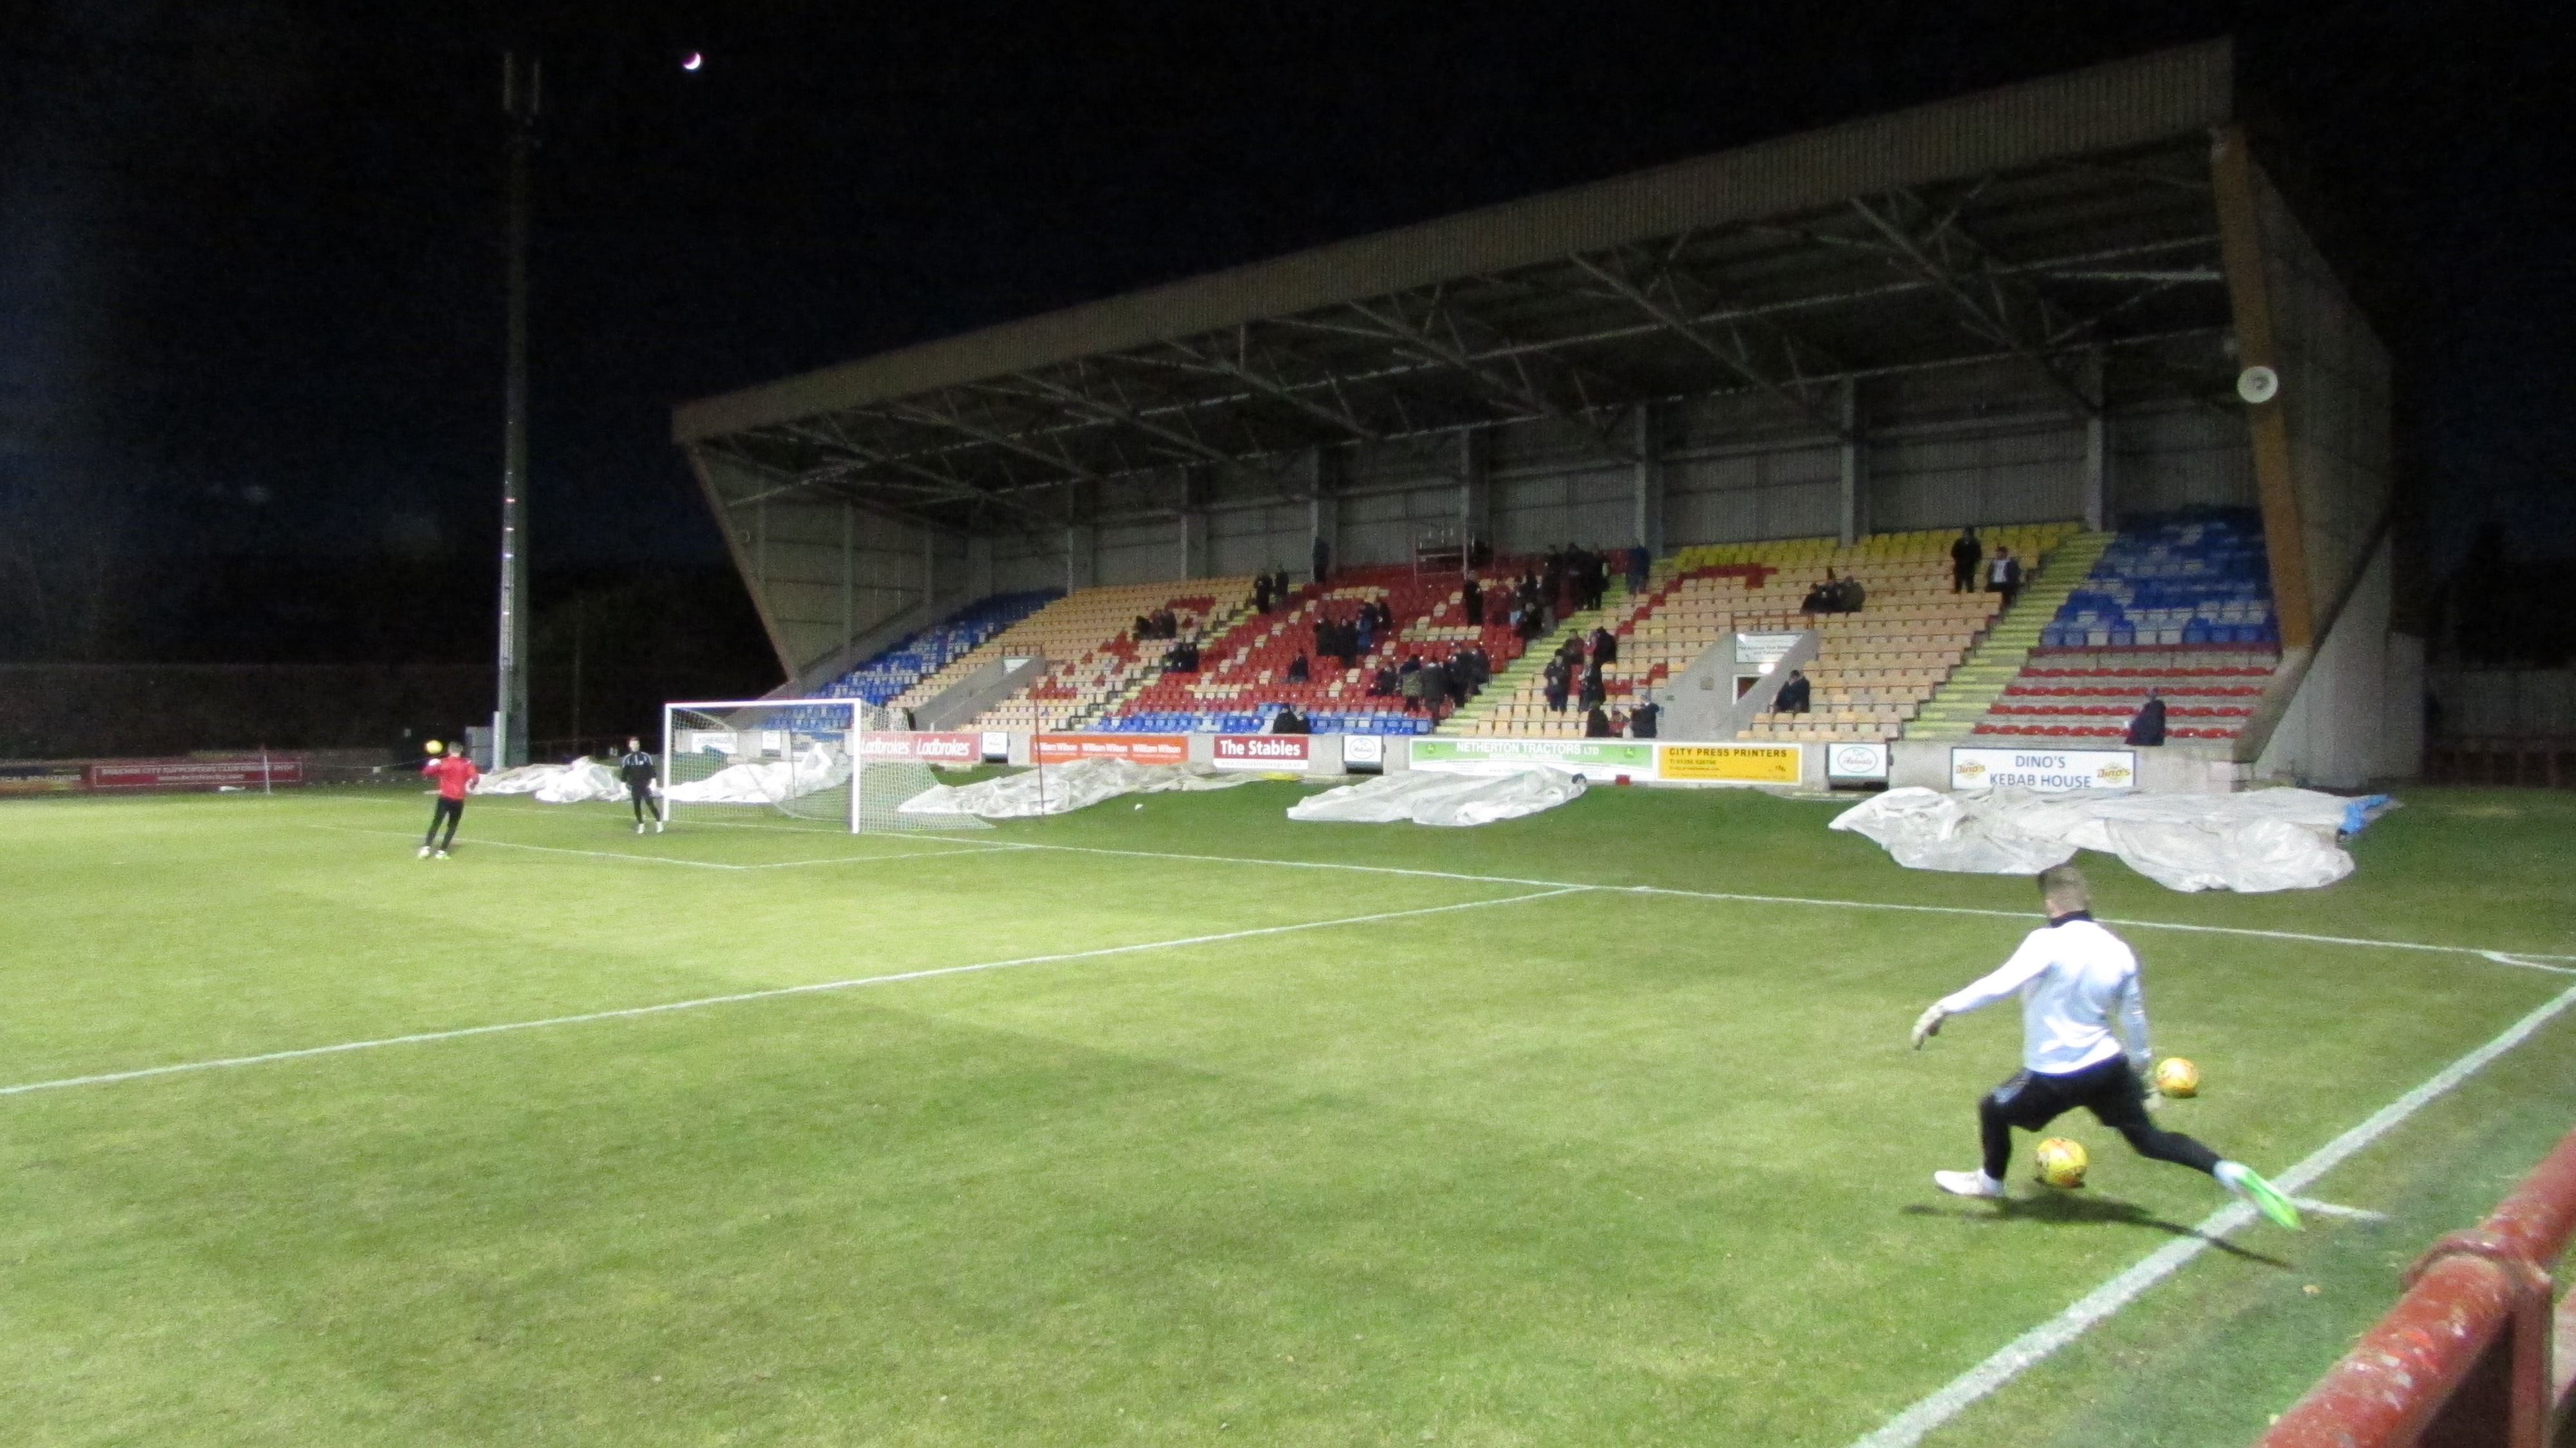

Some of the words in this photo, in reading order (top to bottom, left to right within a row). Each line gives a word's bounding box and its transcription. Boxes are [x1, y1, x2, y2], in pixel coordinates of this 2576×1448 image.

[916, 738, 970, 756] Ladbrokes
[1057, 743, 1077, 751] Wilson
[1082, 743, 1105, 752] William
[1106, 743, 1128, 752] Wilson
[1132, 744, 1157, 752] William
[1158, 744, 1181, 753] Wilson
[1220, 740, 1245, 755] The
[1248, 740, 1300, 756] Stables
[1457, 742, 1520, 752] NETHERTON
[1522, 743, 1581, 754] TRACTORS
[1584, 747, 1599, 755] LTD
[1669, 748, 1692, 756] CITY
[1697, 748, 1729, 757] PRESS
[1734, 748, 1787, 757] PRINTERS
[2016, 756, 2065, 768] DINO'S
[1956, 765, 1985, 774] Dino's
[2098, 767, 2130, 777] Dino's
[1990, 774, 2035, 786] KEBAB
[2041, 775, 2091, 788] HOUSE
